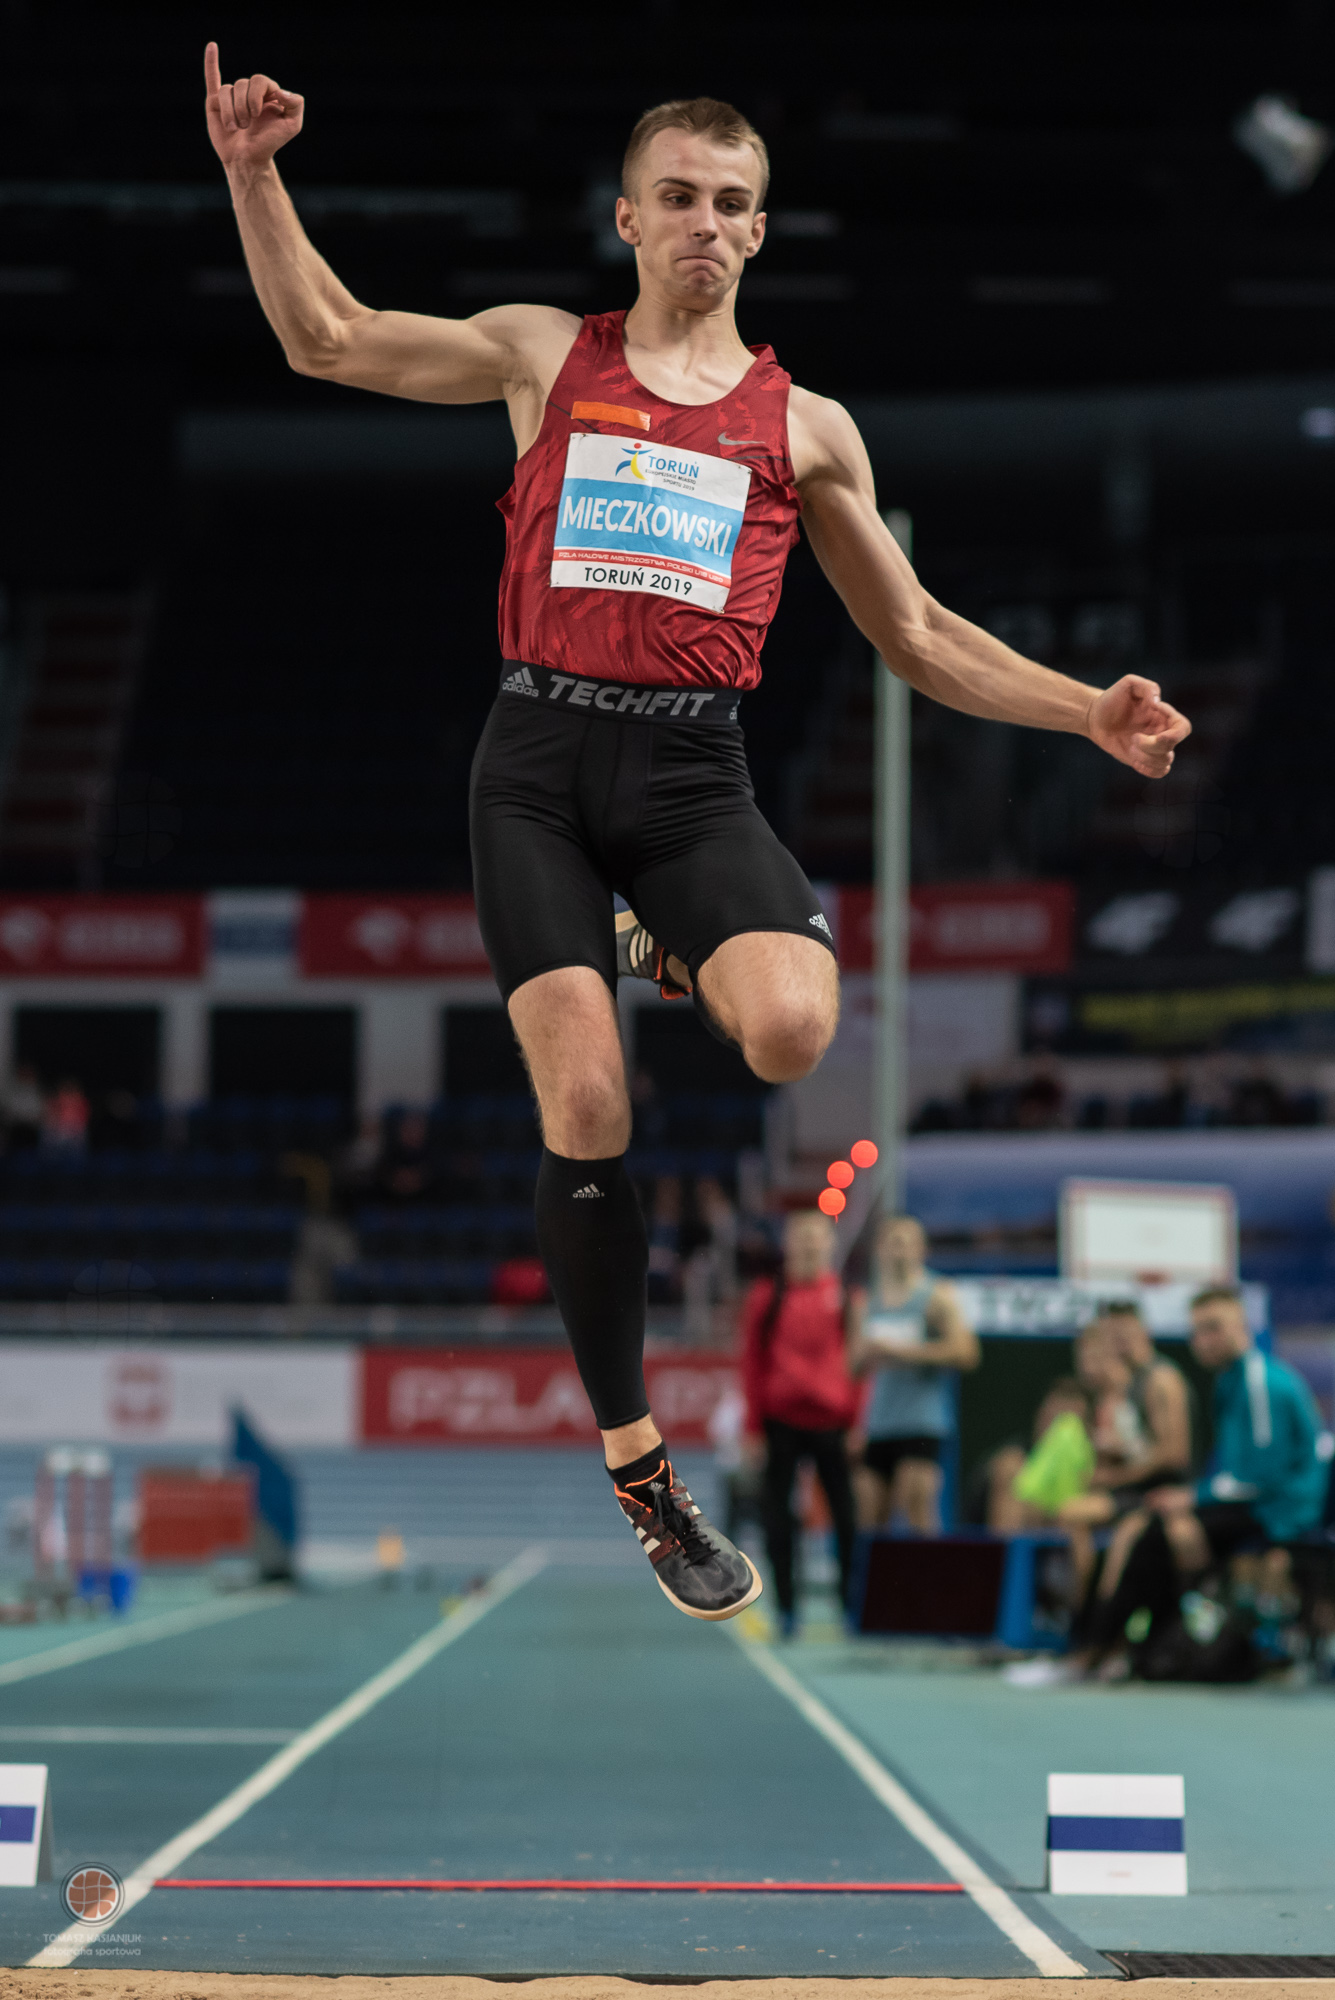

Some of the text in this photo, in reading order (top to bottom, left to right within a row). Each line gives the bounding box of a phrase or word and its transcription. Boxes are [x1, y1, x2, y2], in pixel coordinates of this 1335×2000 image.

[562, 496, 732, 557] MIECZKOWSKI
[558, 551, 577, 559] PZLA
[577, 552, 609, 561] HALOWE
[610, 554, 666, 567] MISTRZOSTWA
[666, 562, 694, 574] POLSKI
[584, 566, 693, 596] TORUŃ 2019
[502, 680, 540, 698] adidas
[548, 674, 716, 718] TECHFIT
[572, 1191, 605, 1199] adidas
